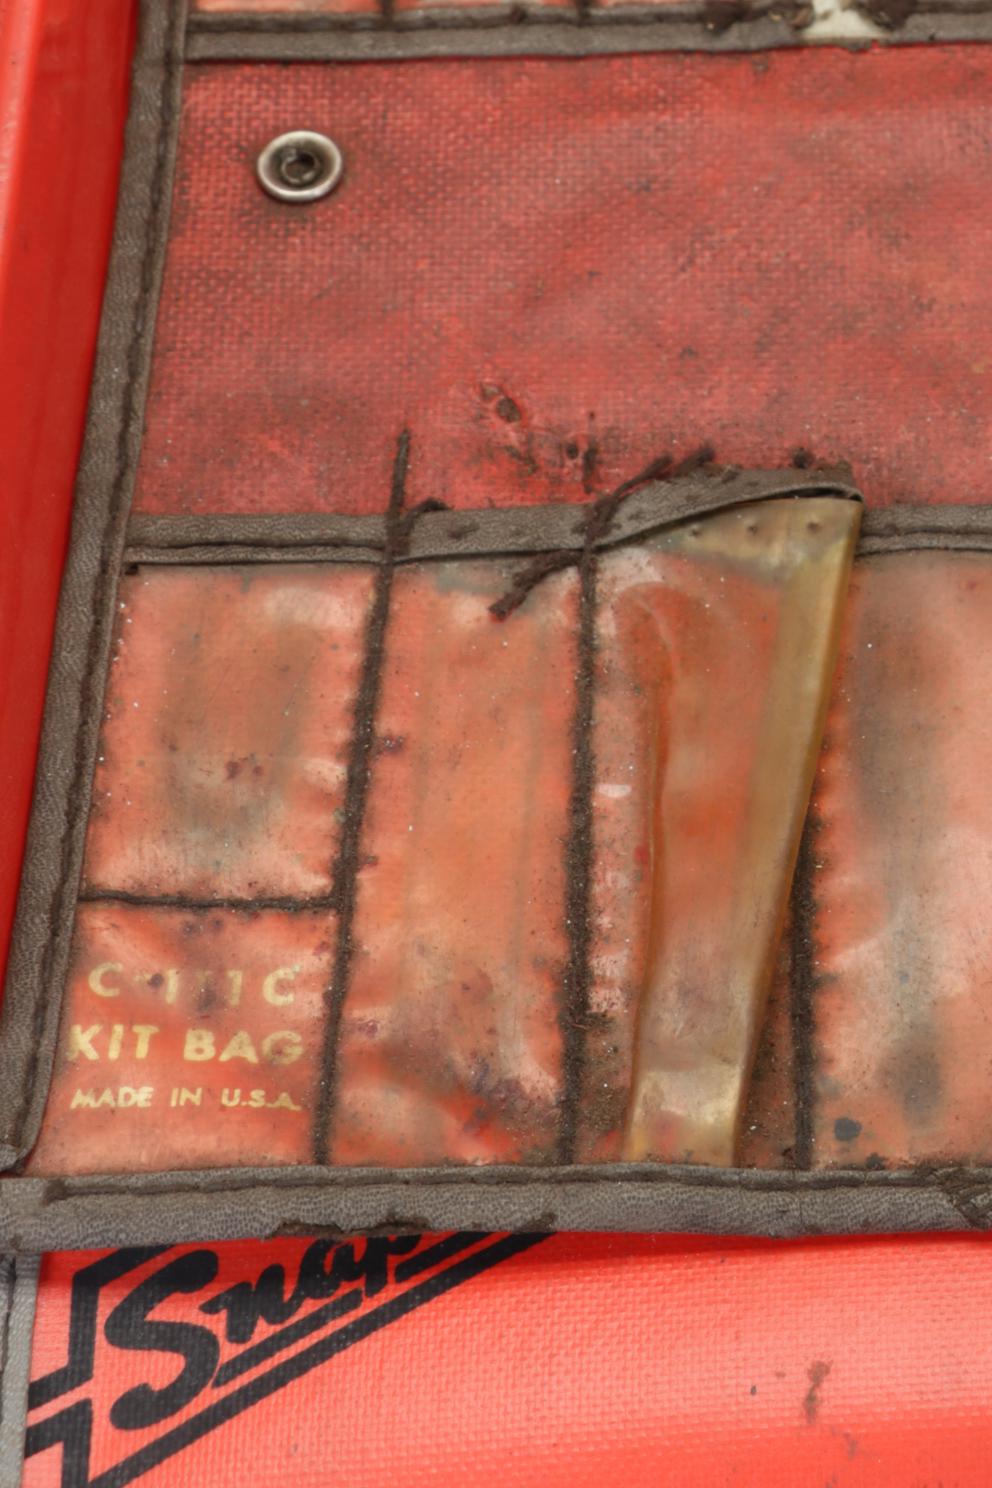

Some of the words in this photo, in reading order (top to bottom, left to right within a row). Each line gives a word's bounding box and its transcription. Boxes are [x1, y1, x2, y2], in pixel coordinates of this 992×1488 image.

[68, 1023, 160, 1062] KIT
[183, 1027, 305, 1064] BAG
[70, 1085, 154, 1110] MADE
[169, 1086, 203, 1108] IN
